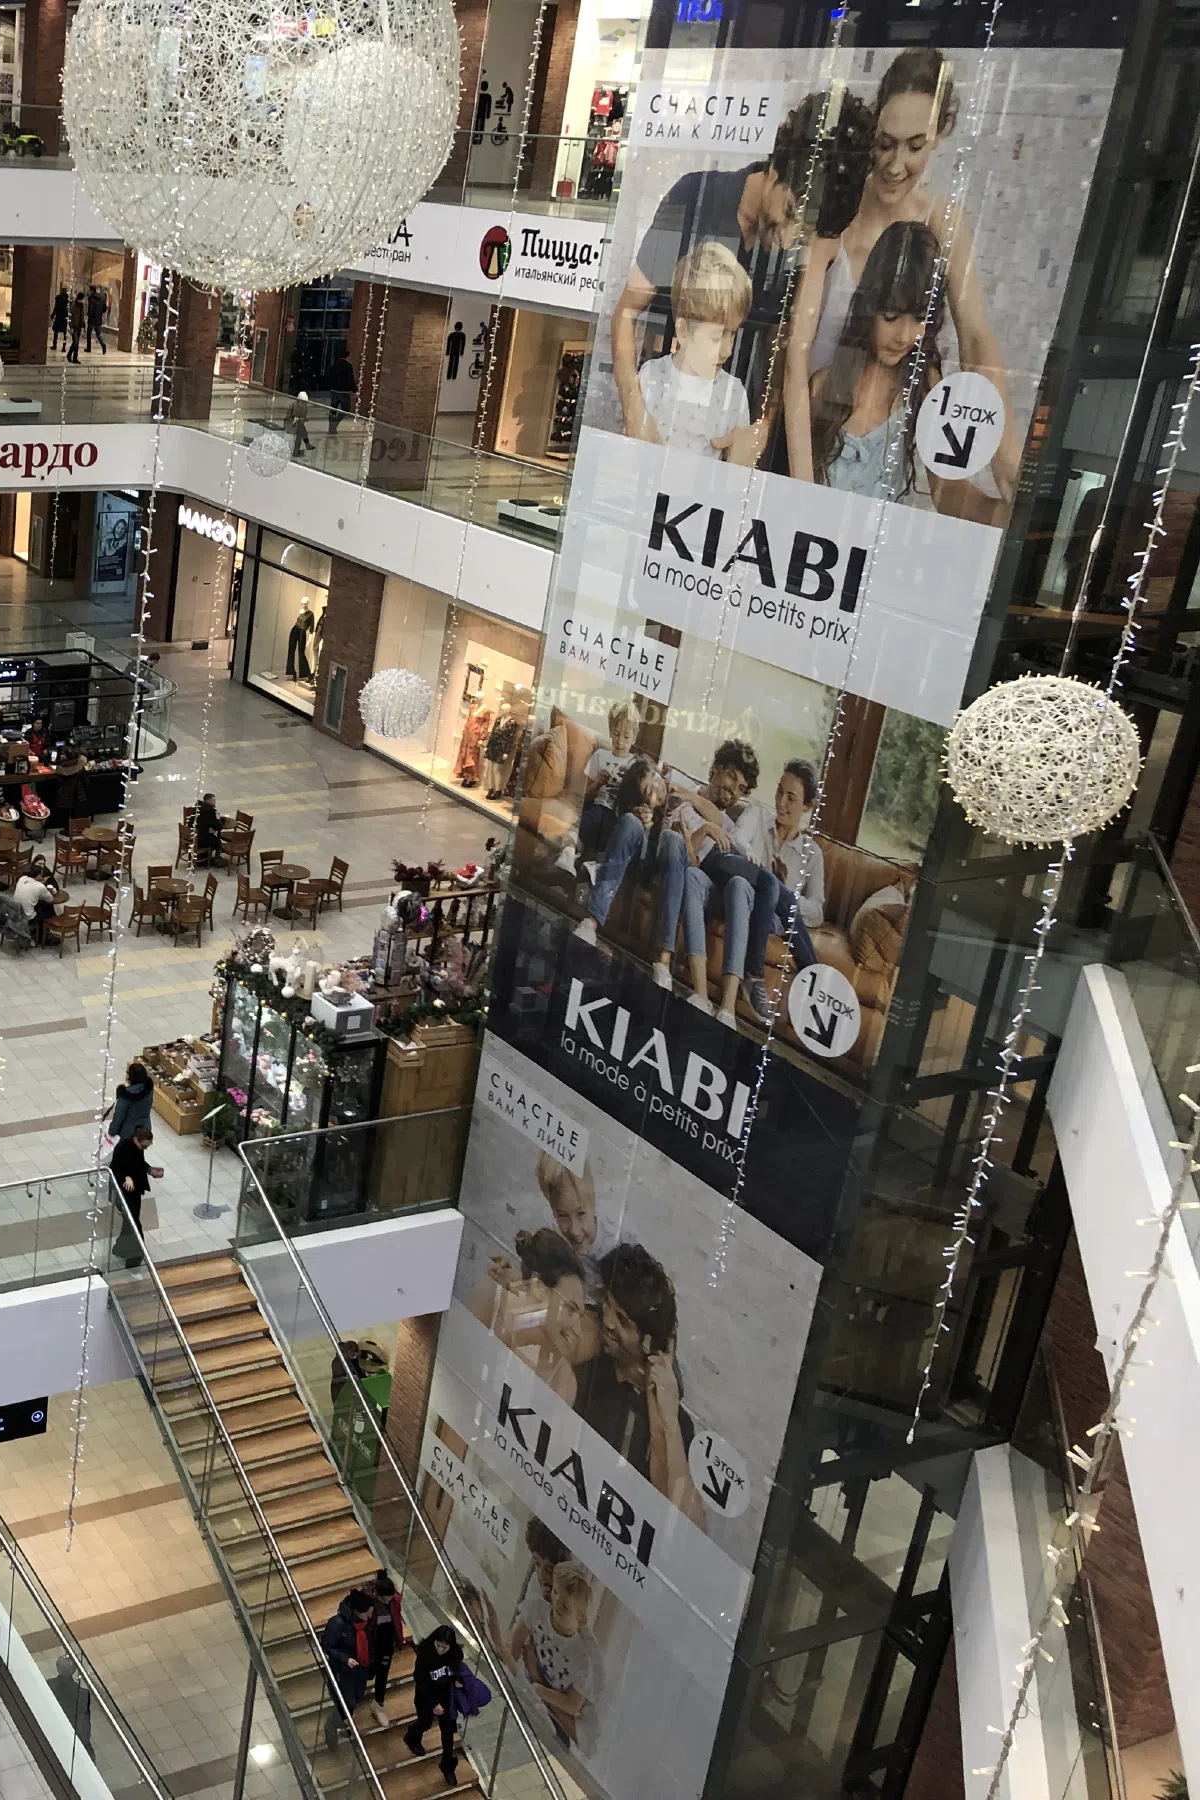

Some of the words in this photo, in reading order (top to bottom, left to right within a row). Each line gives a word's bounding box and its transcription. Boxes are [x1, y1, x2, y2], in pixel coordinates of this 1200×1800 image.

[645, 121, 680, 139] ВАМ
[691, 123, 702, 139] К
[711, 124, 764, 144] ЛИЦУ
[650, 94, 770, 118] СЧАСТЬЕ
[514, 264, 577, 288] итальянский
[579, 276, 600, 292] рес
[951, 404, 998, 426] этаж
[178, 504, 237, 548] MANGO
[648, 491, 868, 613] KIABI
[643, 554, 660, 580] la
[665, 566, 724, 601] mode
[729, 583, 742, 608] à
[747, 594, 806, 630] petits
[809, 614, 851, 645] prix
[559, 640, 590, 664] ВАМ
[599, 656, 608, 671] К
[615, 663, 661, 691] ЛИЦУ
[562, 619, 665, 673] СЧАСТЬЕ
[817, 990, 855, 1021] этаж
[564, 977, 751, 1139] KIABI
[488, 1090, 515, 1119] ВАМ
[522, 1116, 531, 1129] К
[536, 1128, 576, 1162] ЛИЦУ
[490, 1072, 579, 1148] СЧАСТЬЕ
[560, 1030, 575, 1055] la
[579, 1046, 629, 1092] mode
[634, 1079, 648, 1104] à
[650, 1094, 700, 1140] petits
[702, 1130, 739, 1166] prix
[430, 1460, 455, 1492] ВАМ
[473, 1507, 508, 1545] ЛИЦУ
[433, 1446, 511, 1533] СЧАСТЬЕ
[494, 1427, 507, 1451] la
[510, 1446, 554, 1497] mode
[569, 1506, 613, 1557] petits
[615, 1551, 647, 1590] prix
[498, 1382, 656, 1567] KIABI
[713, 1455, 745, 1490] этаж
